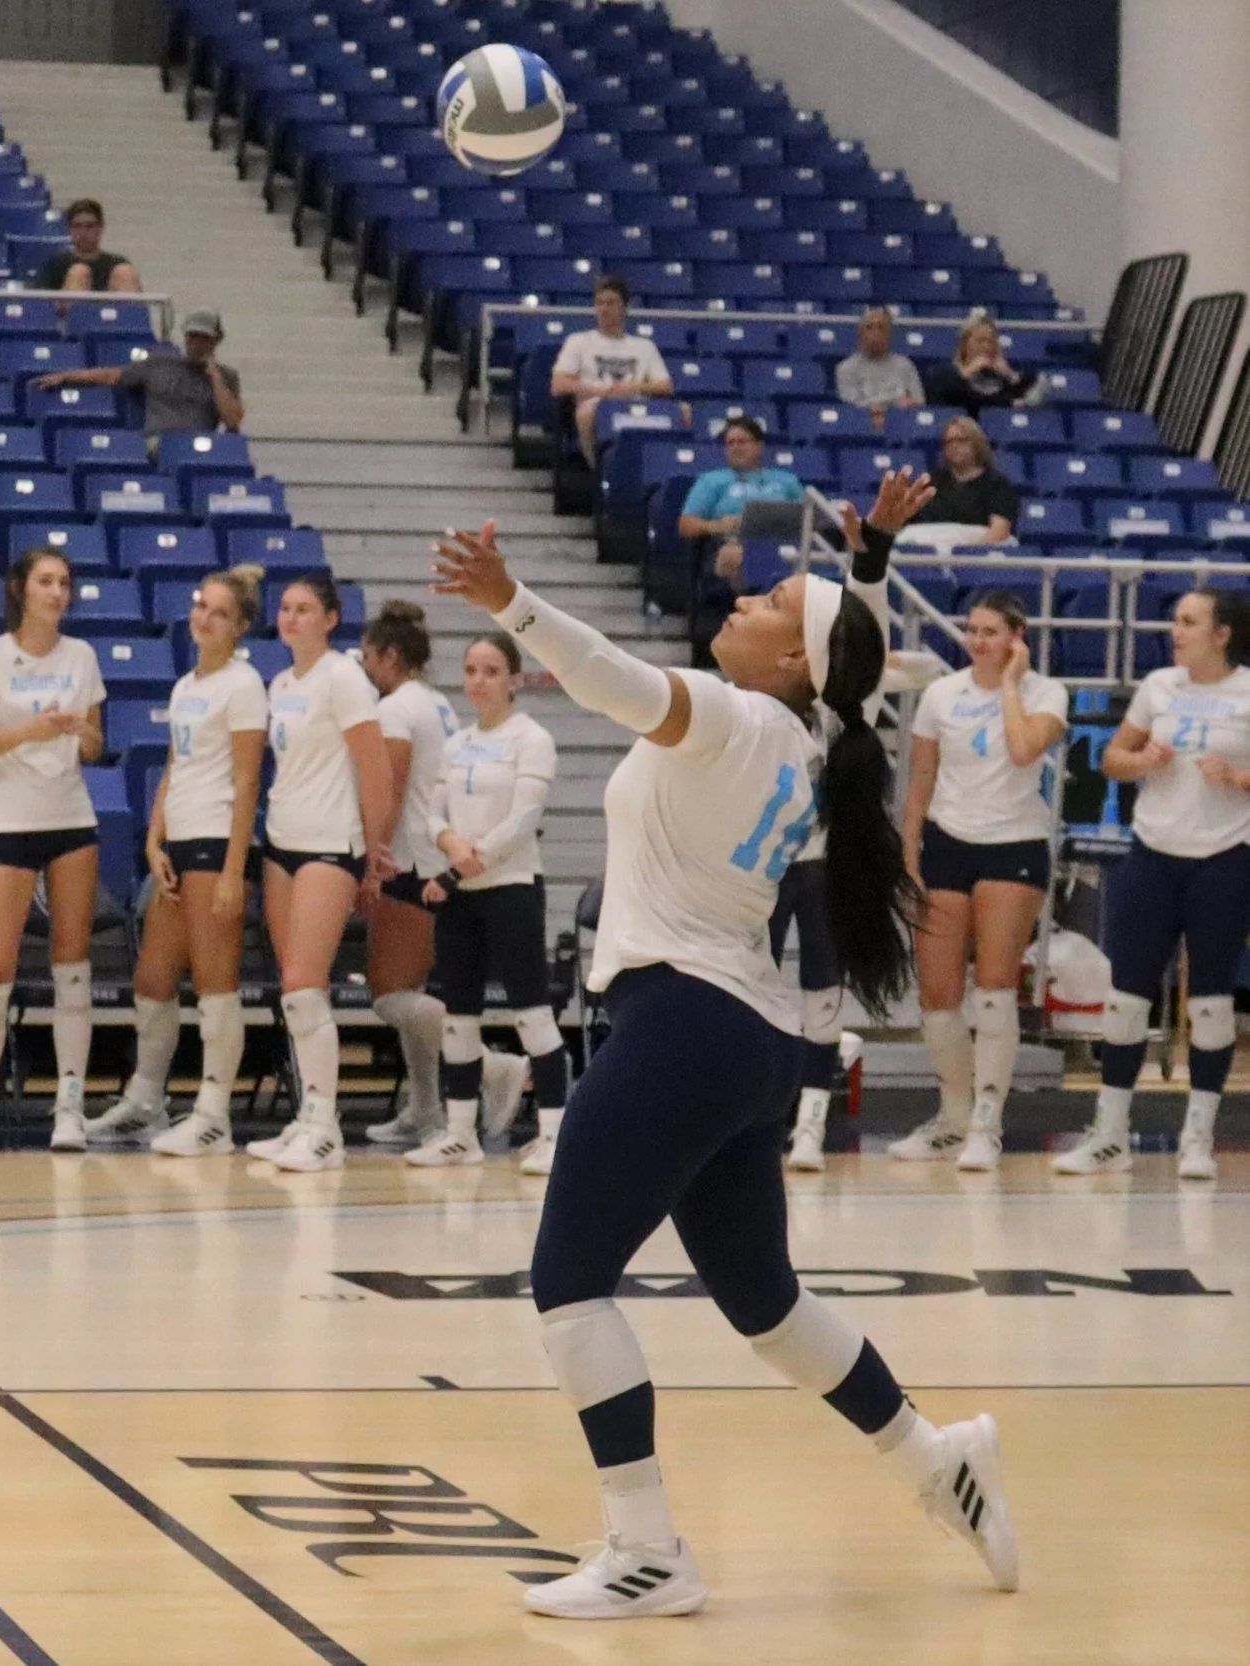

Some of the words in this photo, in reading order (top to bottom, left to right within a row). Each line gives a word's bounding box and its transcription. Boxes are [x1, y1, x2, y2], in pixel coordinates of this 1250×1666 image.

[971, 726, 988, 757] 4
[1172, 715, 1209, 752] 21
[327, 1268, 1234, 1300] NCAA
